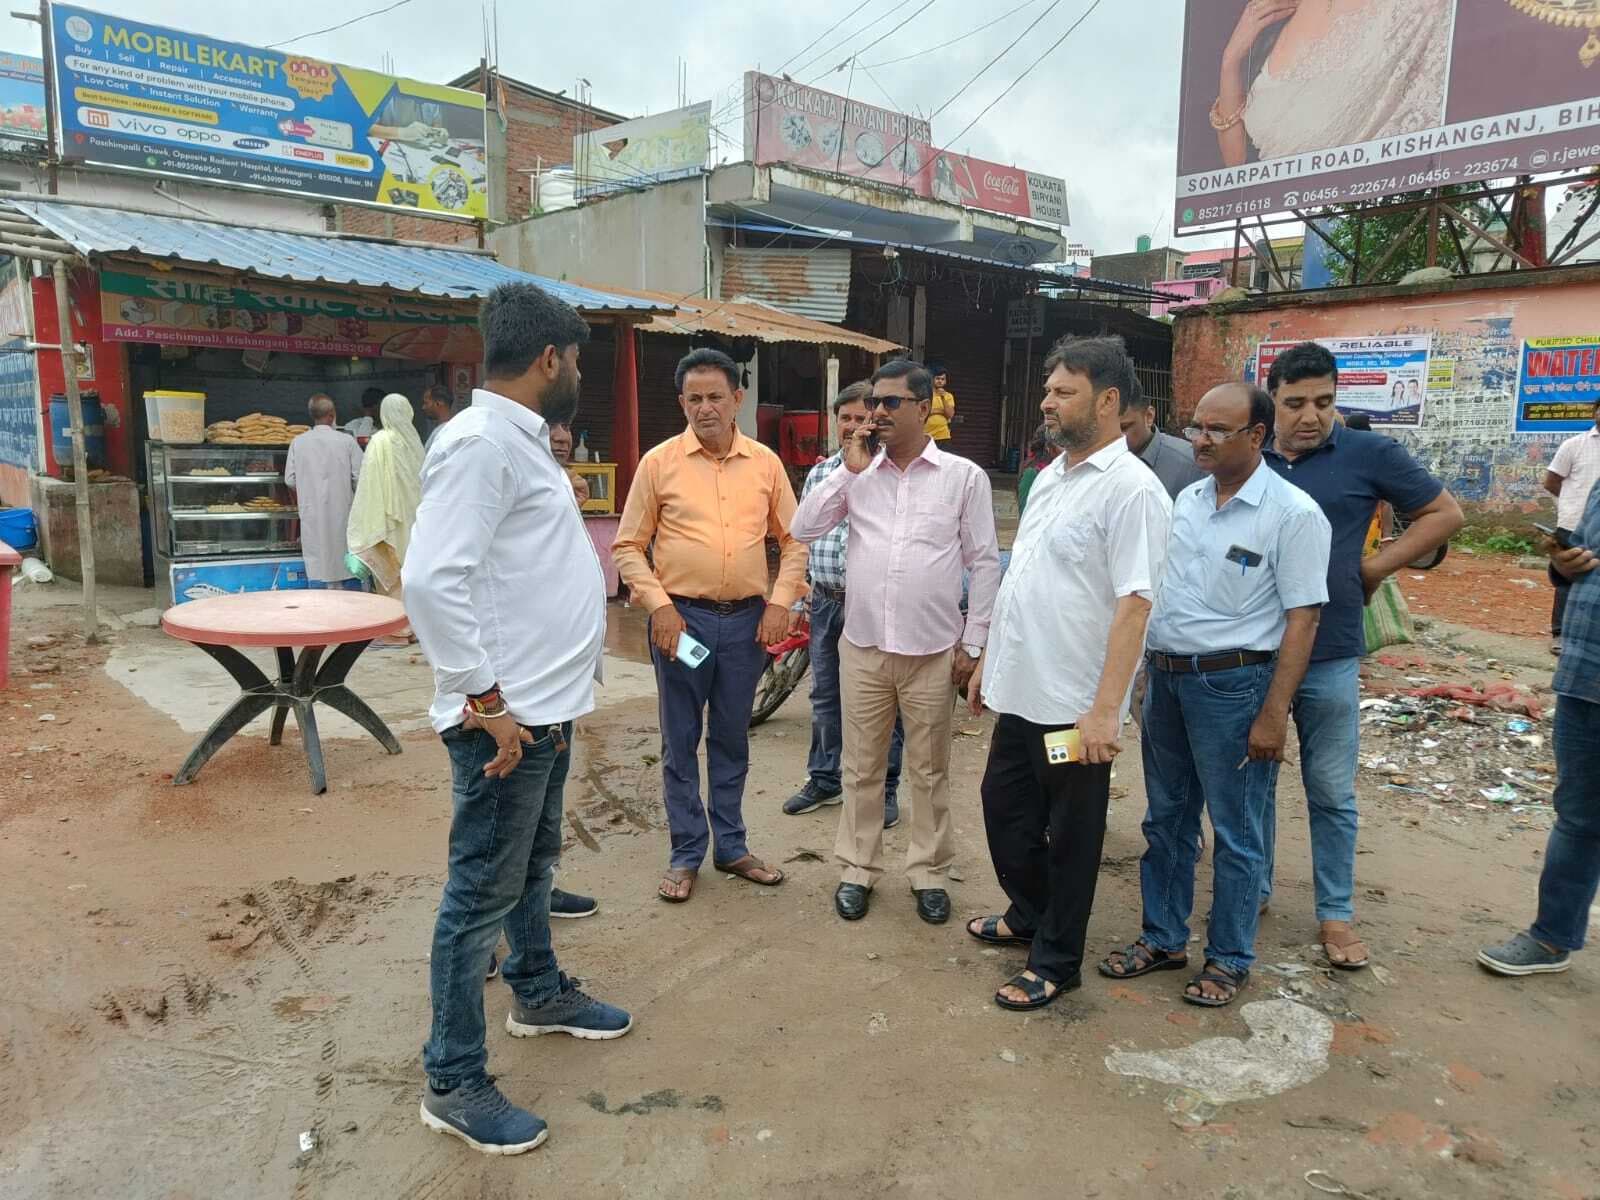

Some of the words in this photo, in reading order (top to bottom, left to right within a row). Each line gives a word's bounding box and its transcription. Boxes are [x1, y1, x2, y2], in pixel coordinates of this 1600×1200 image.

[74, 44, 93, 56] Buy
[103, 24, 279, 80] MOBILEKART
[118, 53, 135, 63] Sell
[160, 62, 189, 74] Repair
[73, 58, 90, 70] For
[91, 64, 110, 76] any
[111, 64, 133, 78] kind
[134, 72, 145, 80] of
[145, 73, 185, 88] problem
[186, 81, 207, 93] with
[207, 86, 227, 98] your
[228, 88, 259, 103] mobile
[83, 74, 105, 86] Low
[105, 79, 130, 90] Cost
[212, 72, 262, 89] Accessories
[150, 87, 183, 101] Instant
[183, 93, 221, 107] Solution
[238, 103, 279, 120] Warranty
[776, 82, 837, 117] KOLKATA
[839, 100, 889, 133] BIRYANI
[890, 116, 931, 145] HOUSE
[117, 117, 168, 136] vivo
[176, 127, 222, 143] oppo
[1187, 157, 1302, 193] SONARPATTI
[1311, 148, 1370, 171] ROAD,
[1380, 115, 1545, 159] KISHANGANJ,
[1028, 175, 1062, 193] KOLKATA
[1197, 201, 1232, 221] 85217
[1235, 197, 1272, 214] 61618
[1303, 186, 1339, 203] 06456
[1350, 177, 1396, 196] 222674
[1408, 167, 1451, 187] 06456
[1463, 156, 1519, 176] 223674
[1031, 190, 1062, 206] BIRYANI
[1035, 204, 1061, 218] HOUSE
[114, 326, 144, 339] Add.
[1535, 337, 1573, 346] PURIFIED
[1575, 336, 1600, 345] CHILL
[1339, 339, 1414, 350] RELIABLE
